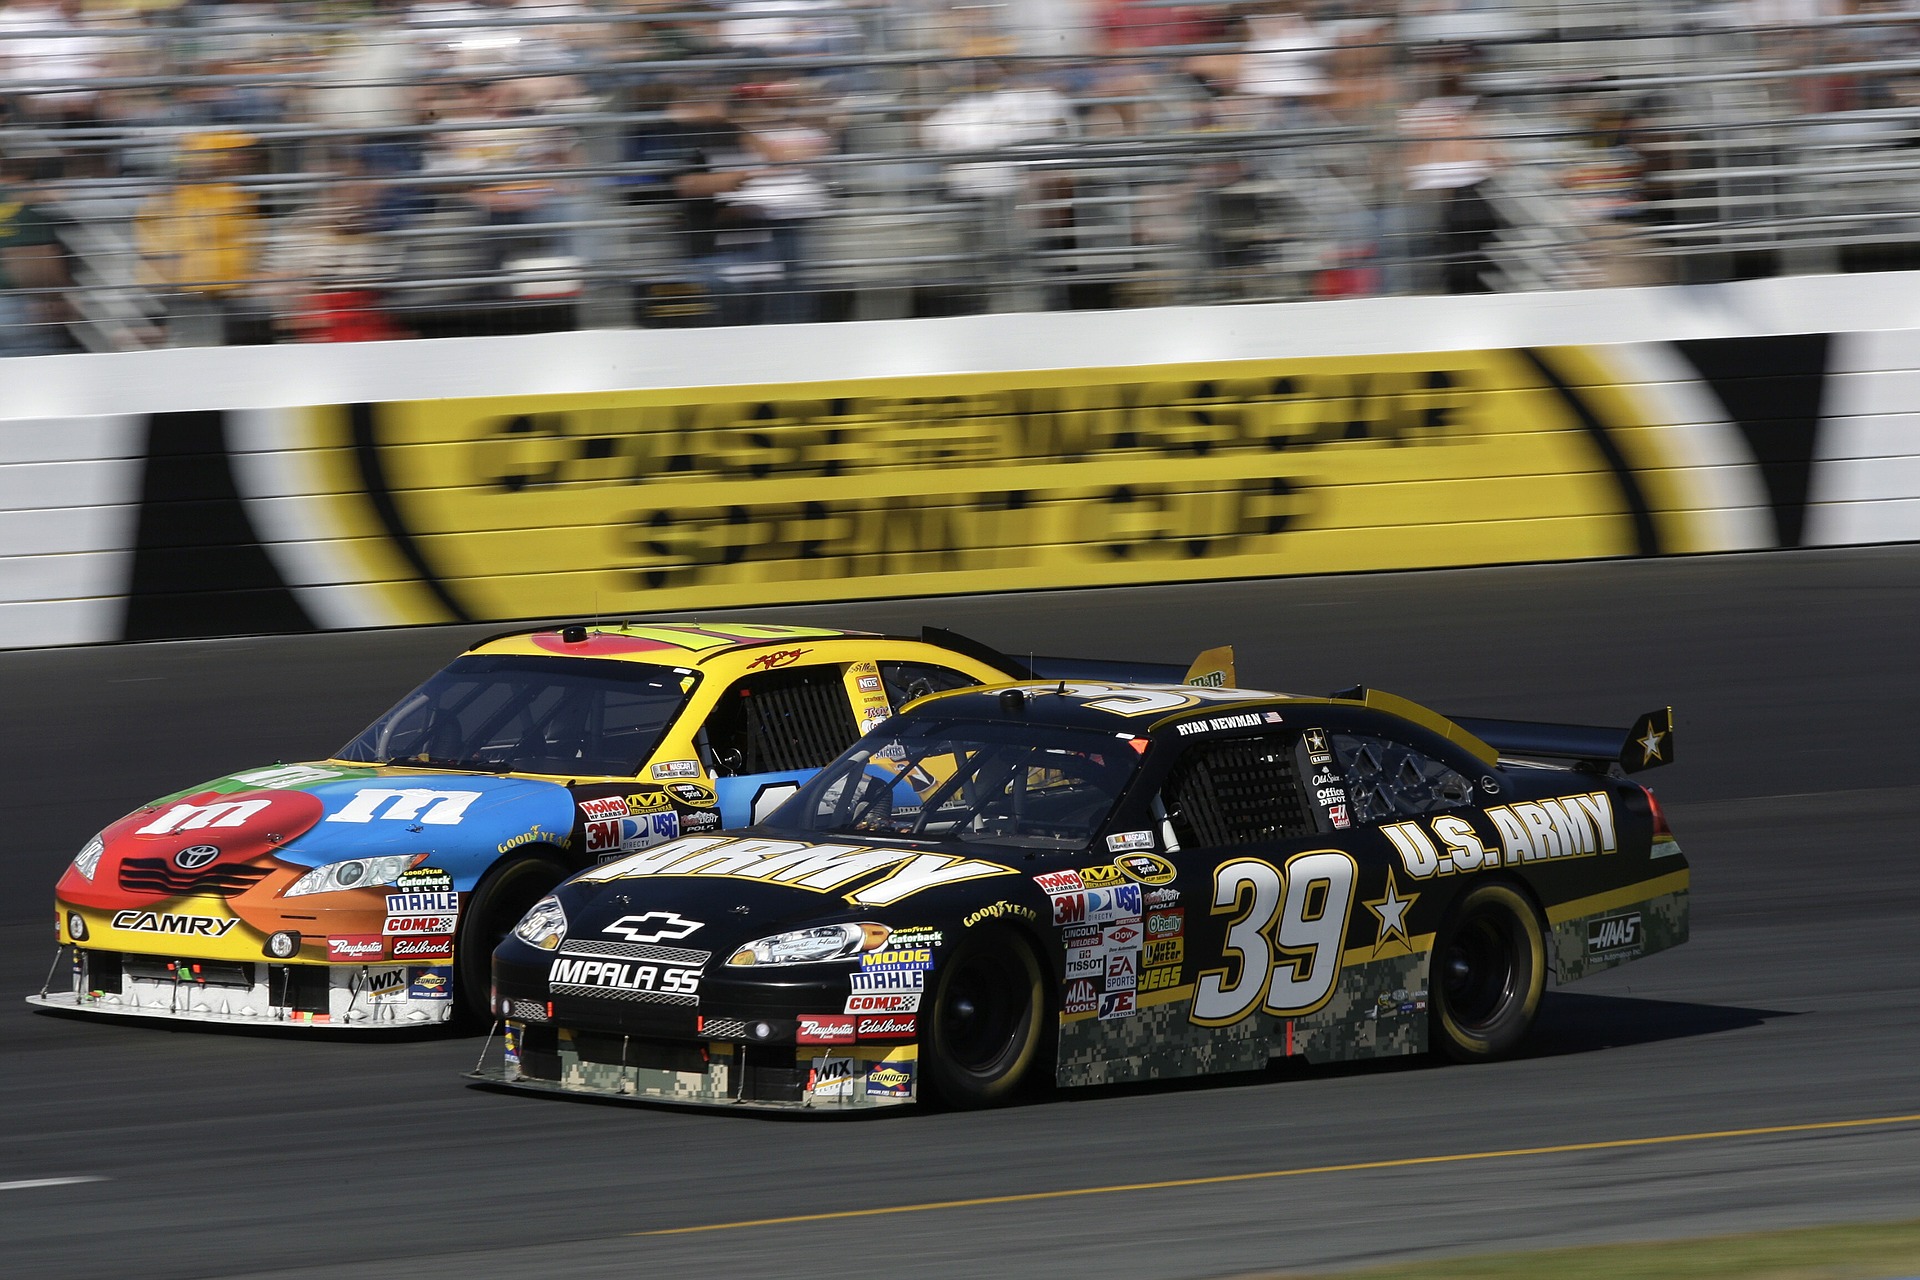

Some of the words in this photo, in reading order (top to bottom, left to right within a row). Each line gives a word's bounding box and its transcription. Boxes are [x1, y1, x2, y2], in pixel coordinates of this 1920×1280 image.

[1176, 720, 1209, 736] RYAN
[1209, 713, 1262, 731] NEWMAN
[1313, 774, 1326, 786] Old
[1317, 788, 1344, 799] Office
[1319, 796, 1346, 806] DEPOT
[583, 799, 627, 815] Holley
[652, 813, 678, 839] USG
[587, 821, 620, 850] 3M
[622, 840, 650, 849] DIRECTV
[567, 836, 1020, 907] ARMY
[397, 875, 451, 887] Gatorback
[1038, 873, 1080, 889] Holley
[402, 885, 450, 893] BELTS
[387, 893, 457, 911] MAHLE
[1115, 885, 1140, 915] USG
[1149, 902, 1175, 910] POLE
[1055, 894, 1084, 925] 3M
[1088, 912, 1113, 921] DIRECTV
[112, 910, 239, 937] CAMRY
[388, 918, 440, 931] COMP
[1149, 915, 1181, 932] O'Reilly
[888, 932, 942, 944] Gatorback
[1064, 927, 1096, 938] LINCOLN
[1189, 849, 1358, 1027] 39
[1588, 916, 1641, 948] HAAS
[328, 940, 383, 956] Raybestos
[393, 940, 450, 954] Edelbrock
[893, 941, 942, 950] BELTS
[1070, 938, 1099, 948] WELDERS
[1155, 941, 1177, 951] Auto
[862, 949, 931, 966] MOOG
[1153, 950, 1181, 962] Meter
[866, 964, 901, 972] CHASSIS
[905, 962, 930, 970] PARTS
[1067, 958, 1103, 972] TISSOT
[1108, 956, 1134, 977] EA
[369, 969, 404, 991] WIX
[415, 977, 445, 985] SUNOCO
[549, 959, 658, 990] IMPALA
[660, 969, 704, 993] SS
[852, 971, 922, 990] MAHLE
[1107, 976, 1135, 988] SPORTS
[1138, 966, 1182, 991] JEGS
[1066, 980, 1097, 1003] MAC
[849, 996, 902, 1010] COMP
[1066, 1002, 1097, 1013] TOOLS
[1099, 991, 1134, 1018] JE
[801, 1021, 853, 1038] Raybestos
[858, 1019, 915, 1033] Edelbrock
[815, 1059, 851, 1081] WIX
[871, 1073, 908, 1082] SUNOCO
